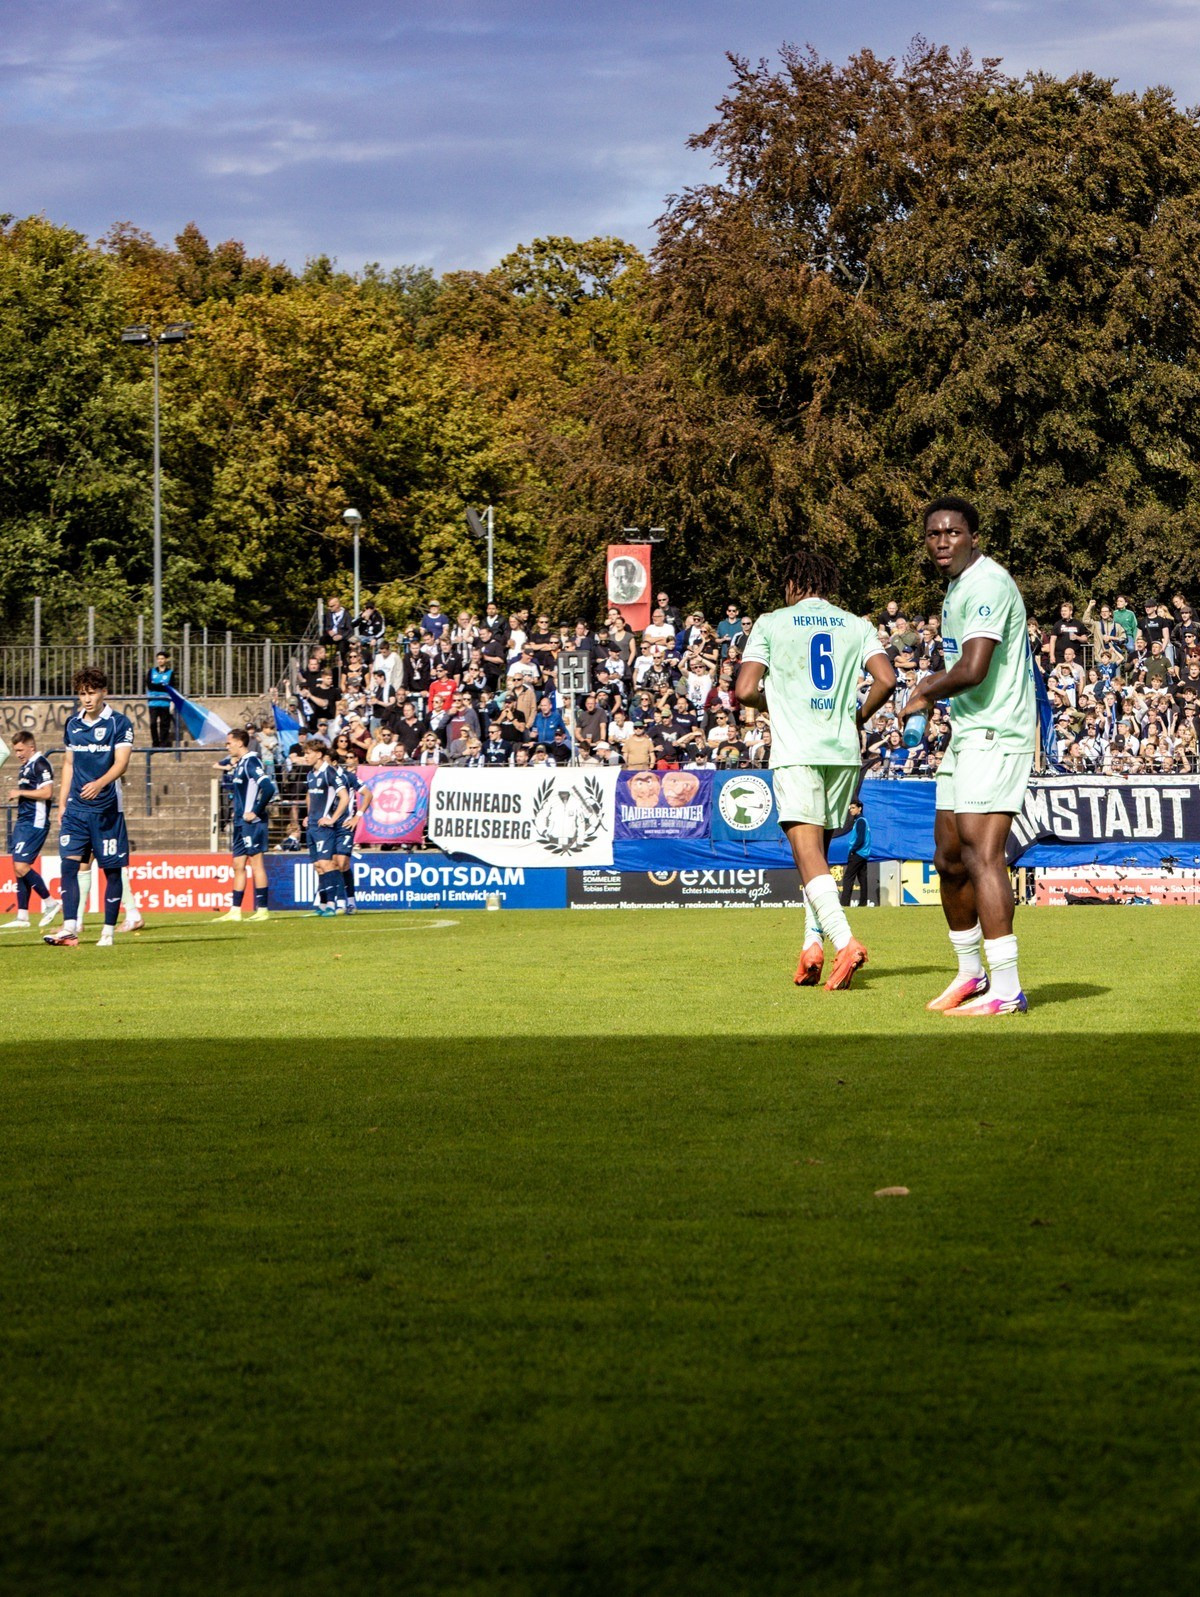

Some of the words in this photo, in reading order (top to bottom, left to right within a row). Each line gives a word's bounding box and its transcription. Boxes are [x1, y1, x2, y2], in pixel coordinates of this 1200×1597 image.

[793, 616, 828, 627] HERTHA
[830, 617, 846, 628] BSC
[808, 631, 836, 692] 6
[436, 790, 522, 813] SKINHEADS
[621, 804, 705, 823] DAUERBRENNER
[434, 818, 532, 840] BABELSBERG
[102, 838, 118, 856] 18
[680, 869, 768, 886] exner
[163, 889, 194, 908] bei
[197, 892, 234, 908] uns
[355, 891, 398, 902] Wohnen
[406, 891, 440, 902] Bauen
